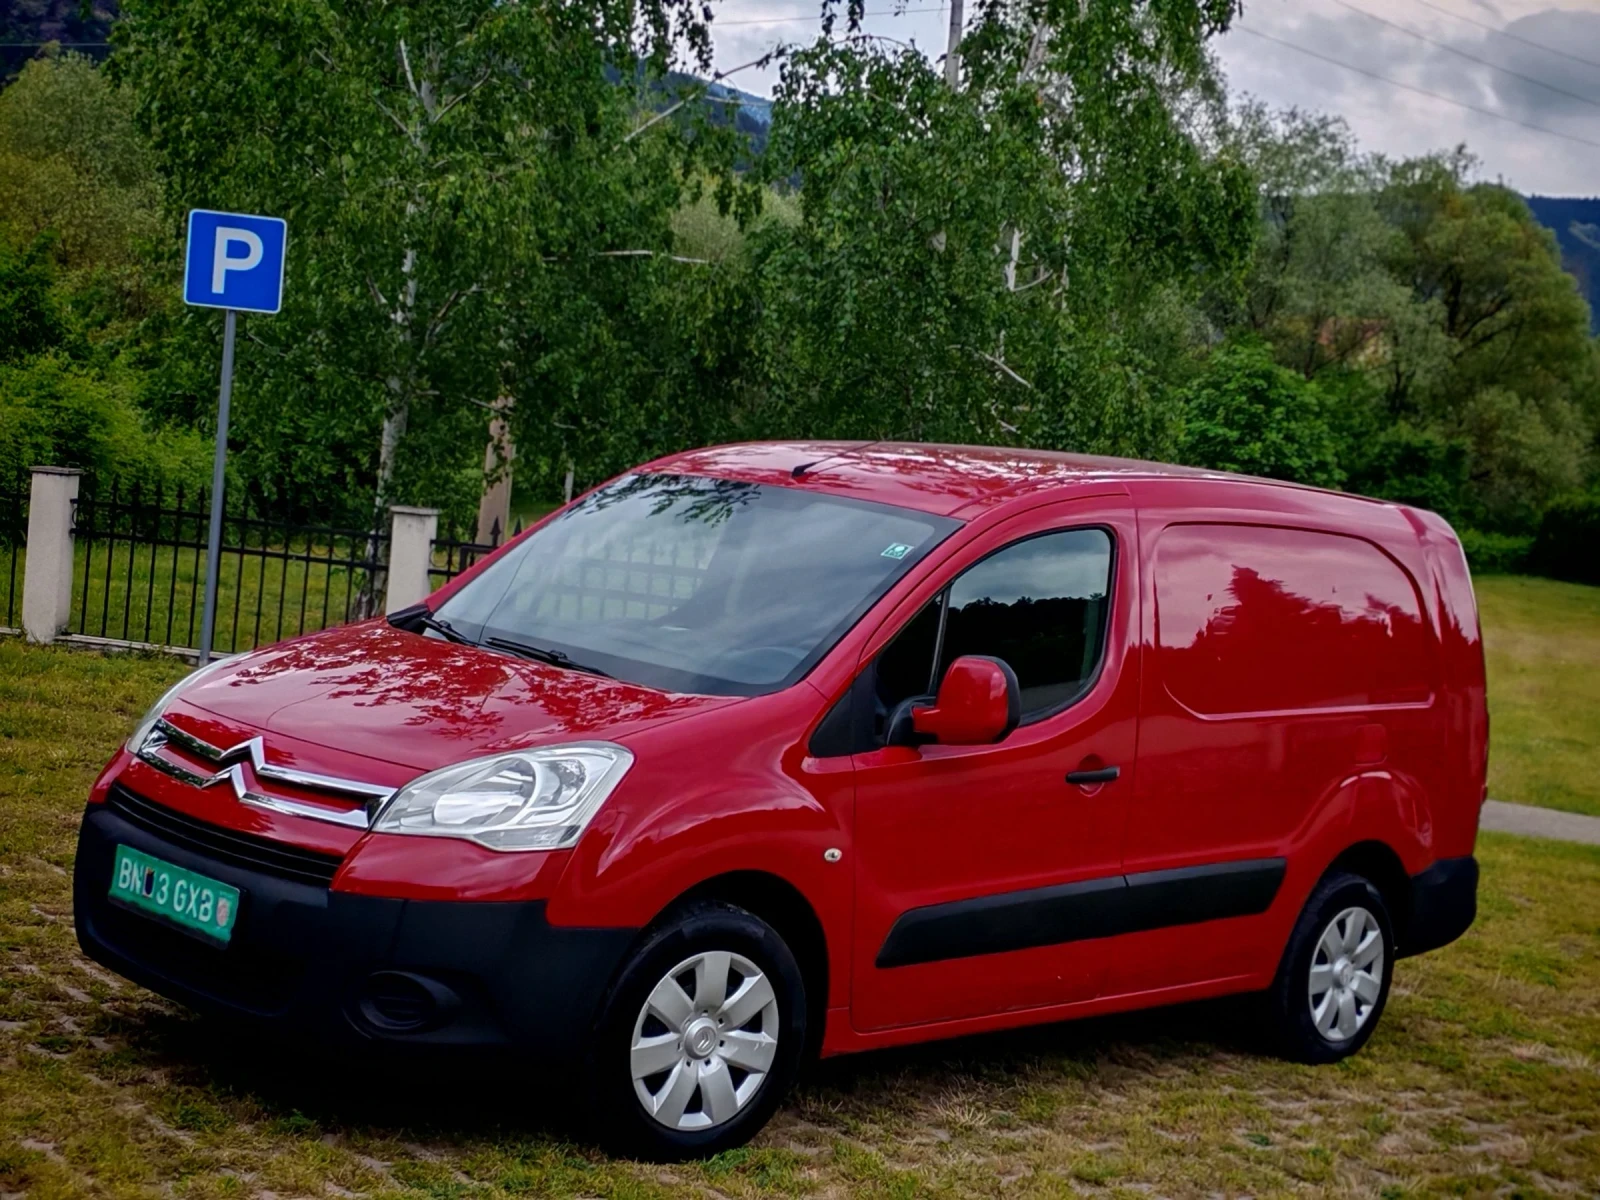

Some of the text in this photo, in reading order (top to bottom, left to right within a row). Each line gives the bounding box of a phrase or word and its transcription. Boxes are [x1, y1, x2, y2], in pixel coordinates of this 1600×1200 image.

[211, 226, 264, 294] P
[118, 857, 144, 895] BN
[156, 872, 170, 905] 3
